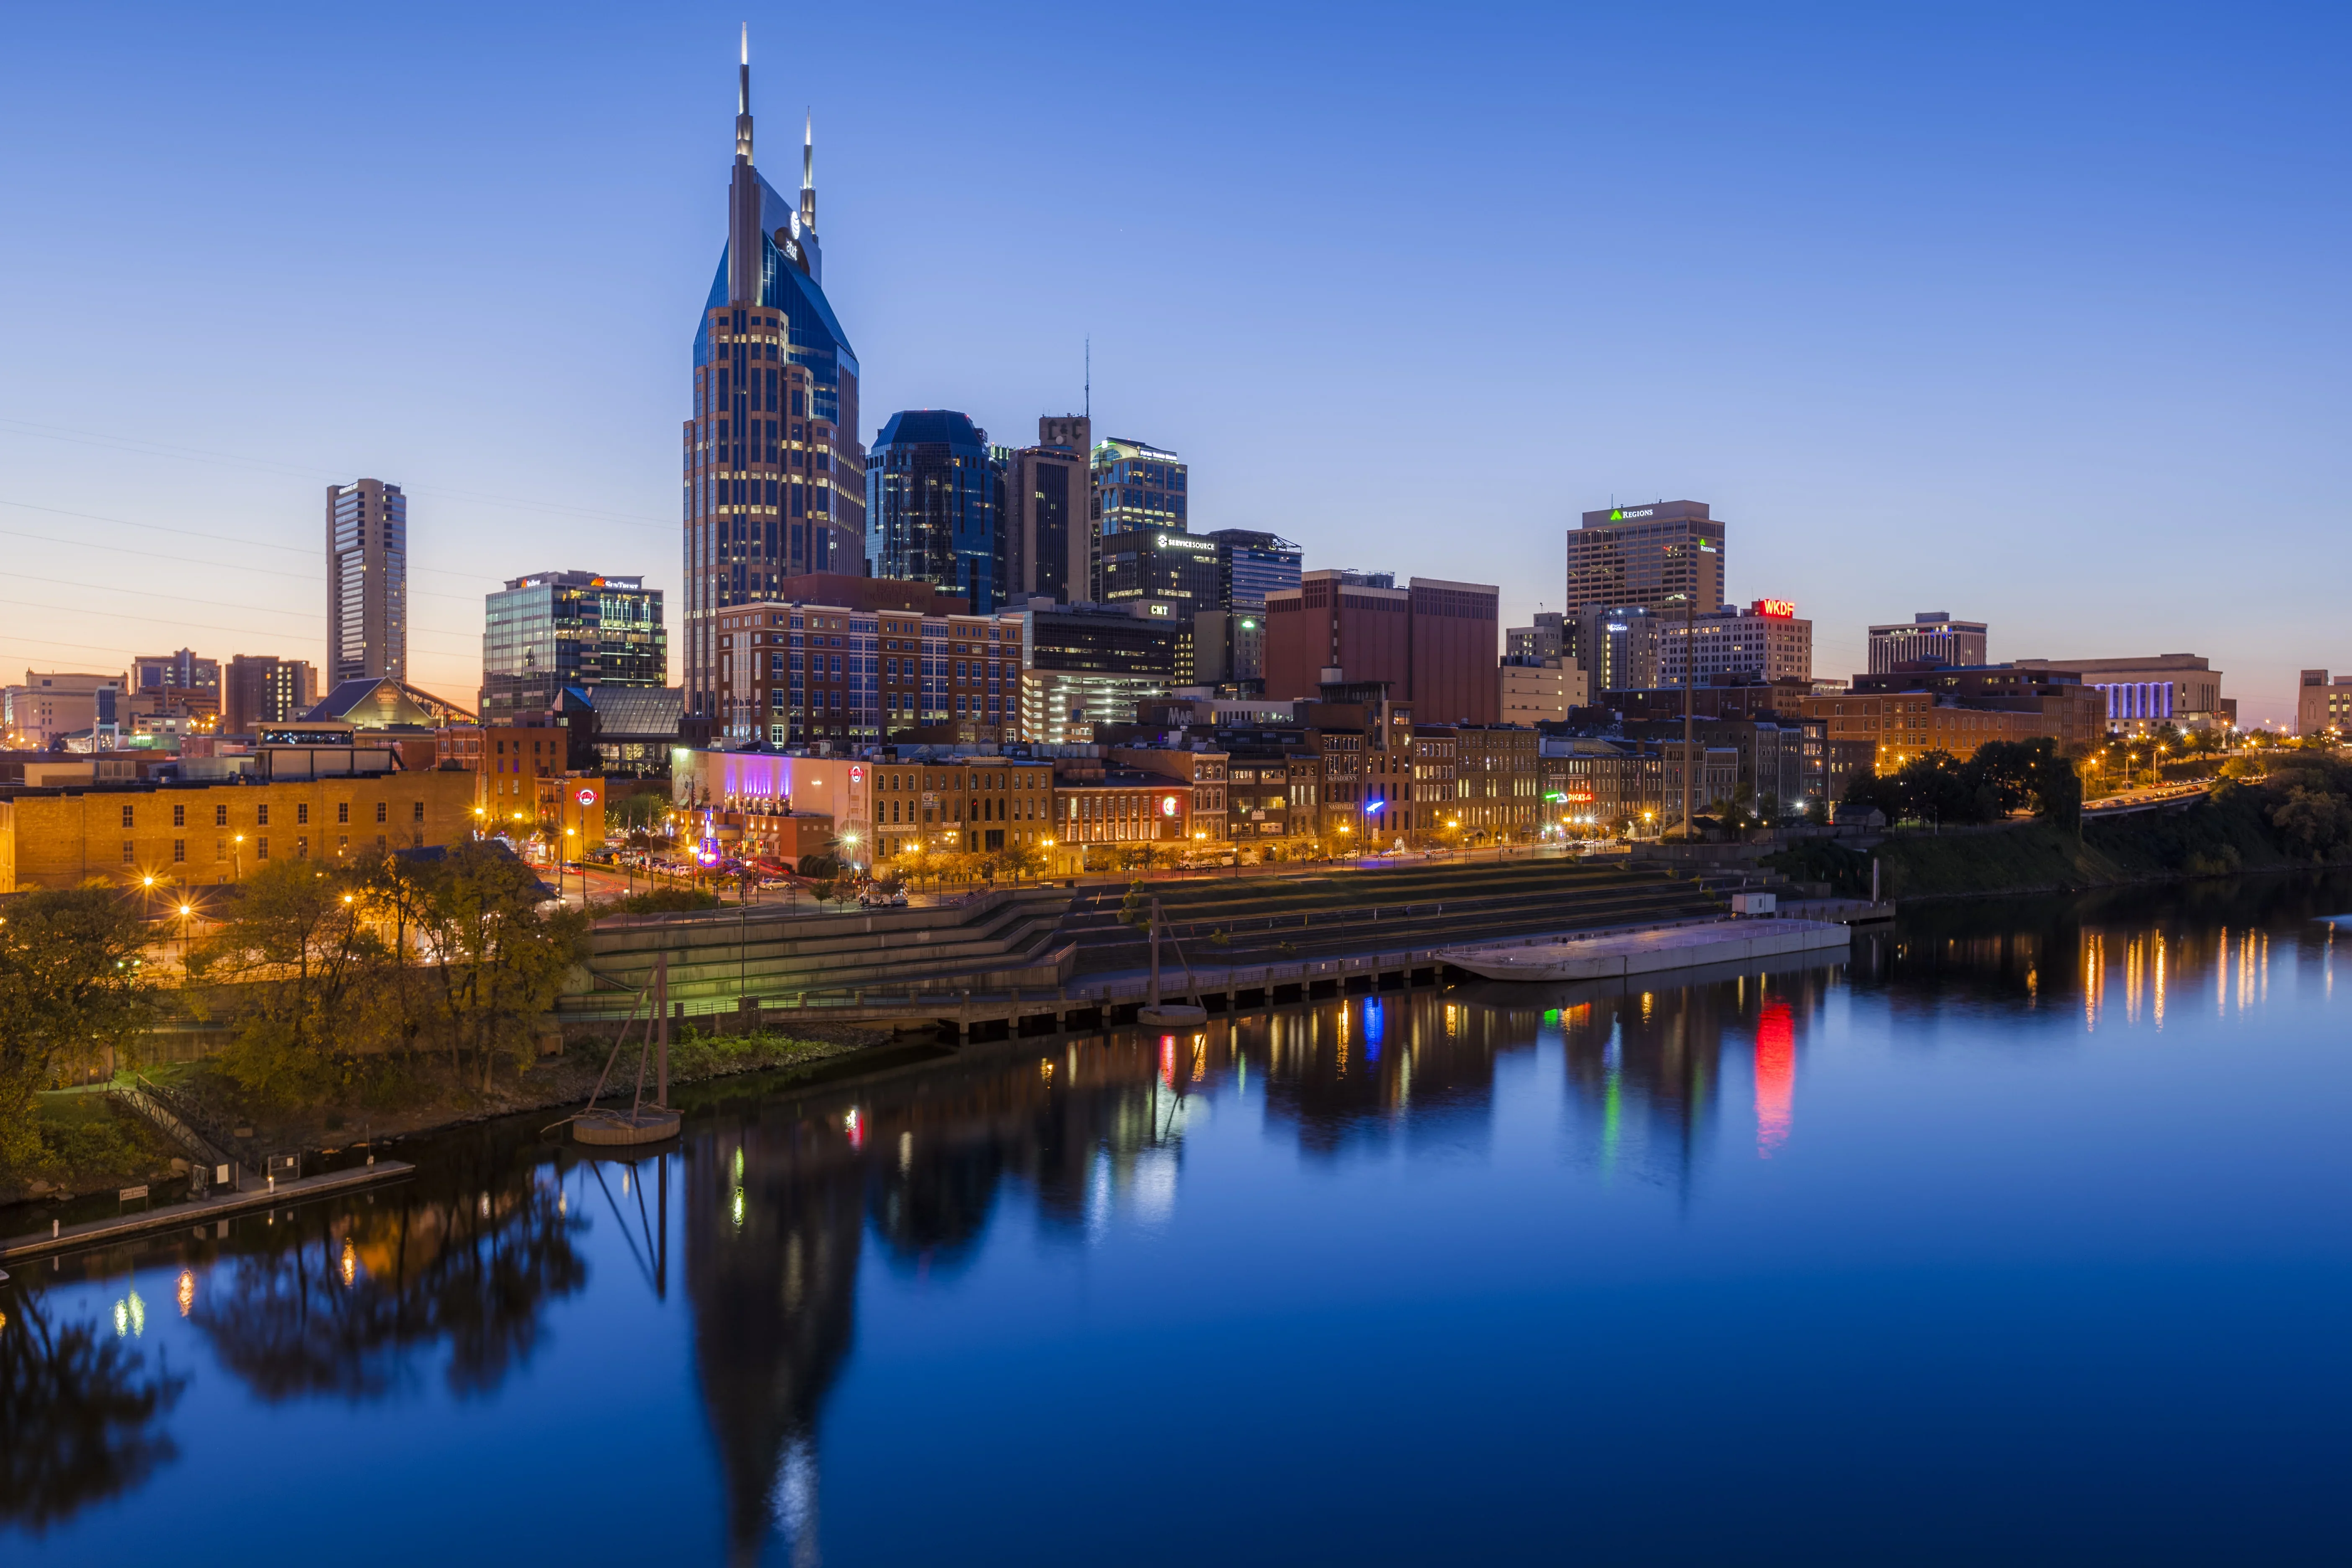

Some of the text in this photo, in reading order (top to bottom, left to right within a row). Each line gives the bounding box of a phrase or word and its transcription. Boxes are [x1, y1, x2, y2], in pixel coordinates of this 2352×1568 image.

[787, 240, 797, 261] at&t
[1622, 509, 1653, 518] REGIONS
[1168, 539, 1215, 550] SERVICESOURCE
[1152, 605, 1168, 615] CMT
[1764, 599, 1795, 616] WKDF
